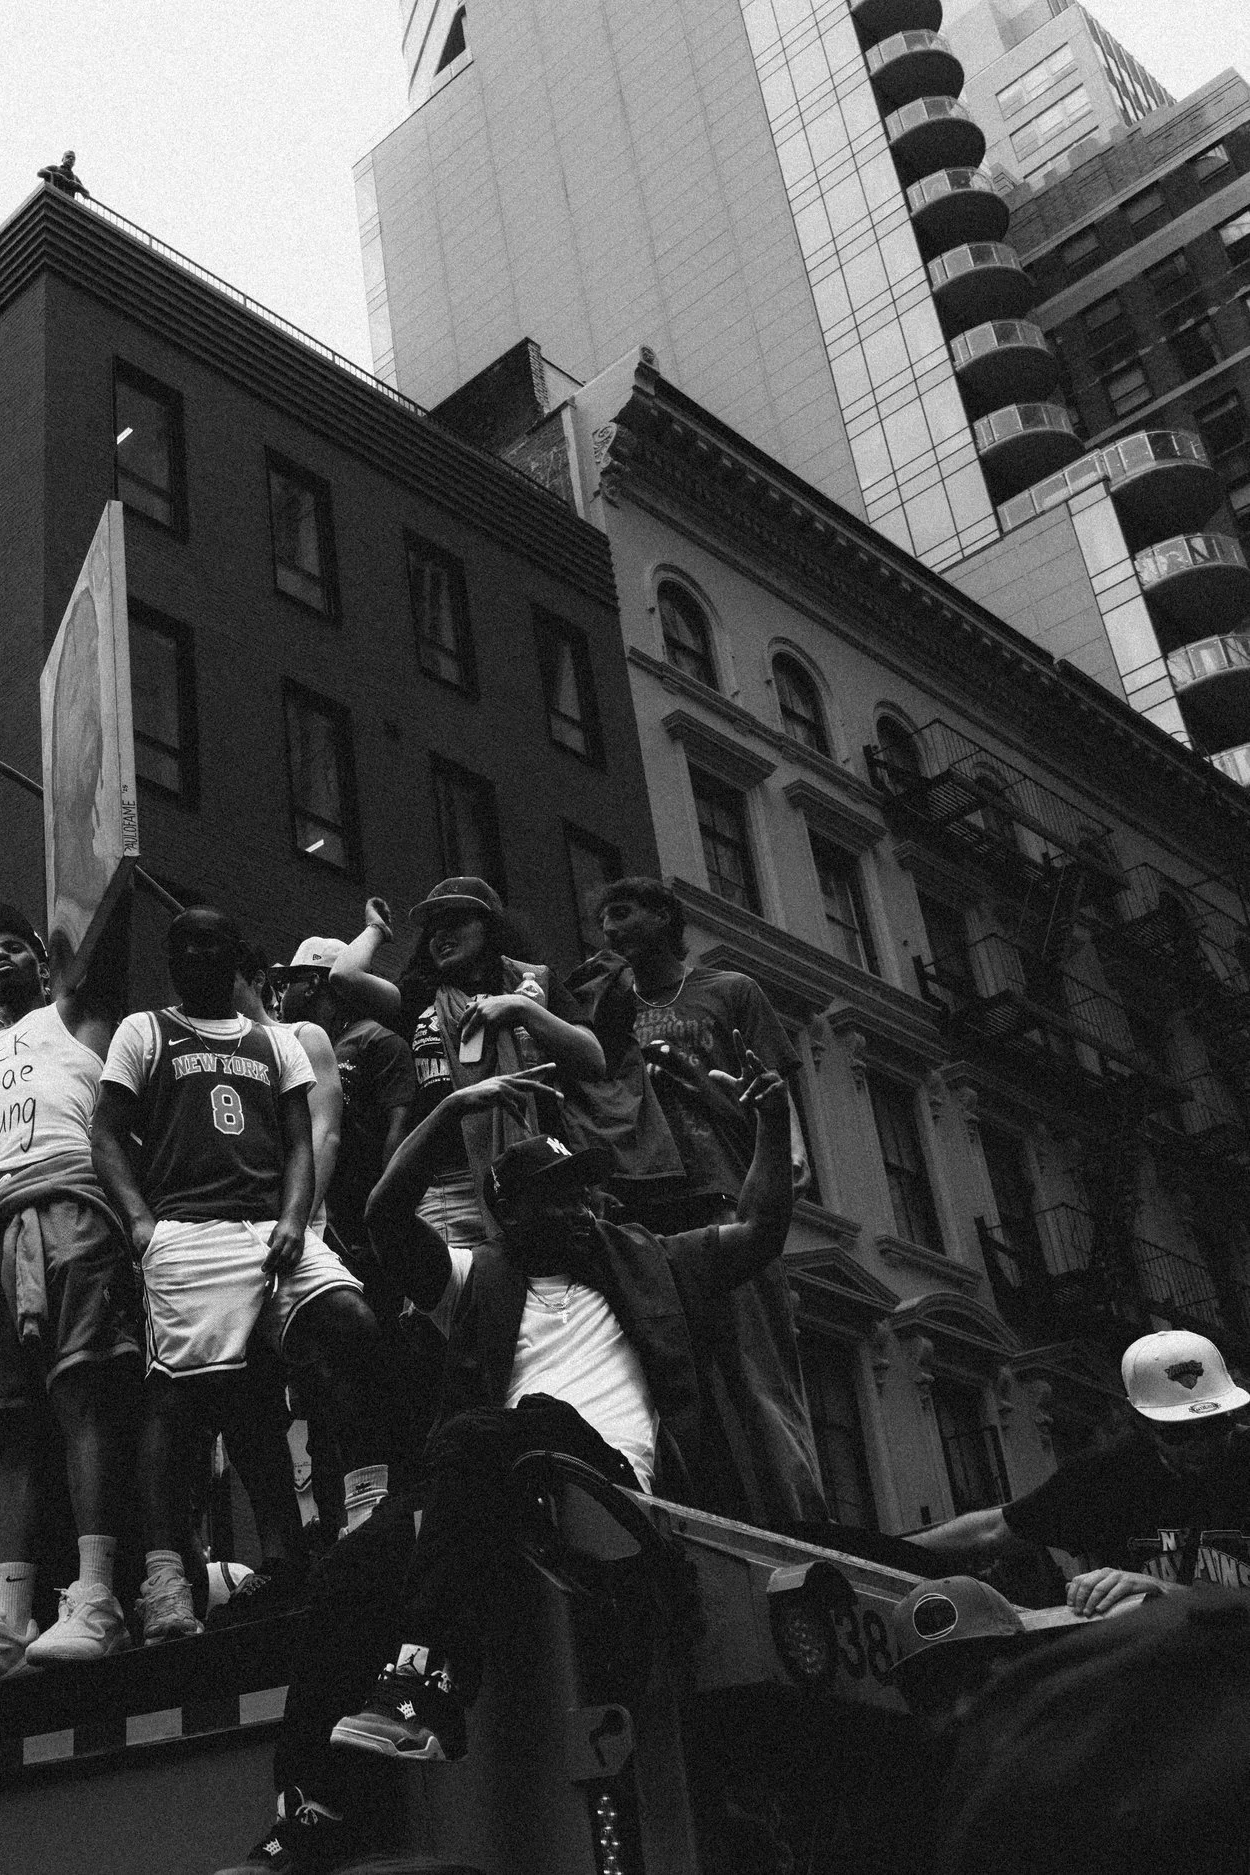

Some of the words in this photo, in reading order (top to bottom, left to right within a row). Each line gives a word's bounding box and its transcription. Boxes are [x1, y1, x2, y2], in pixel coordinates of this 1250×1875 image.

[171, 1052, 218, 1080] NEW
[217, 1055, 271, 1087] YORK
[210, 1084, 245, 1136] 8
